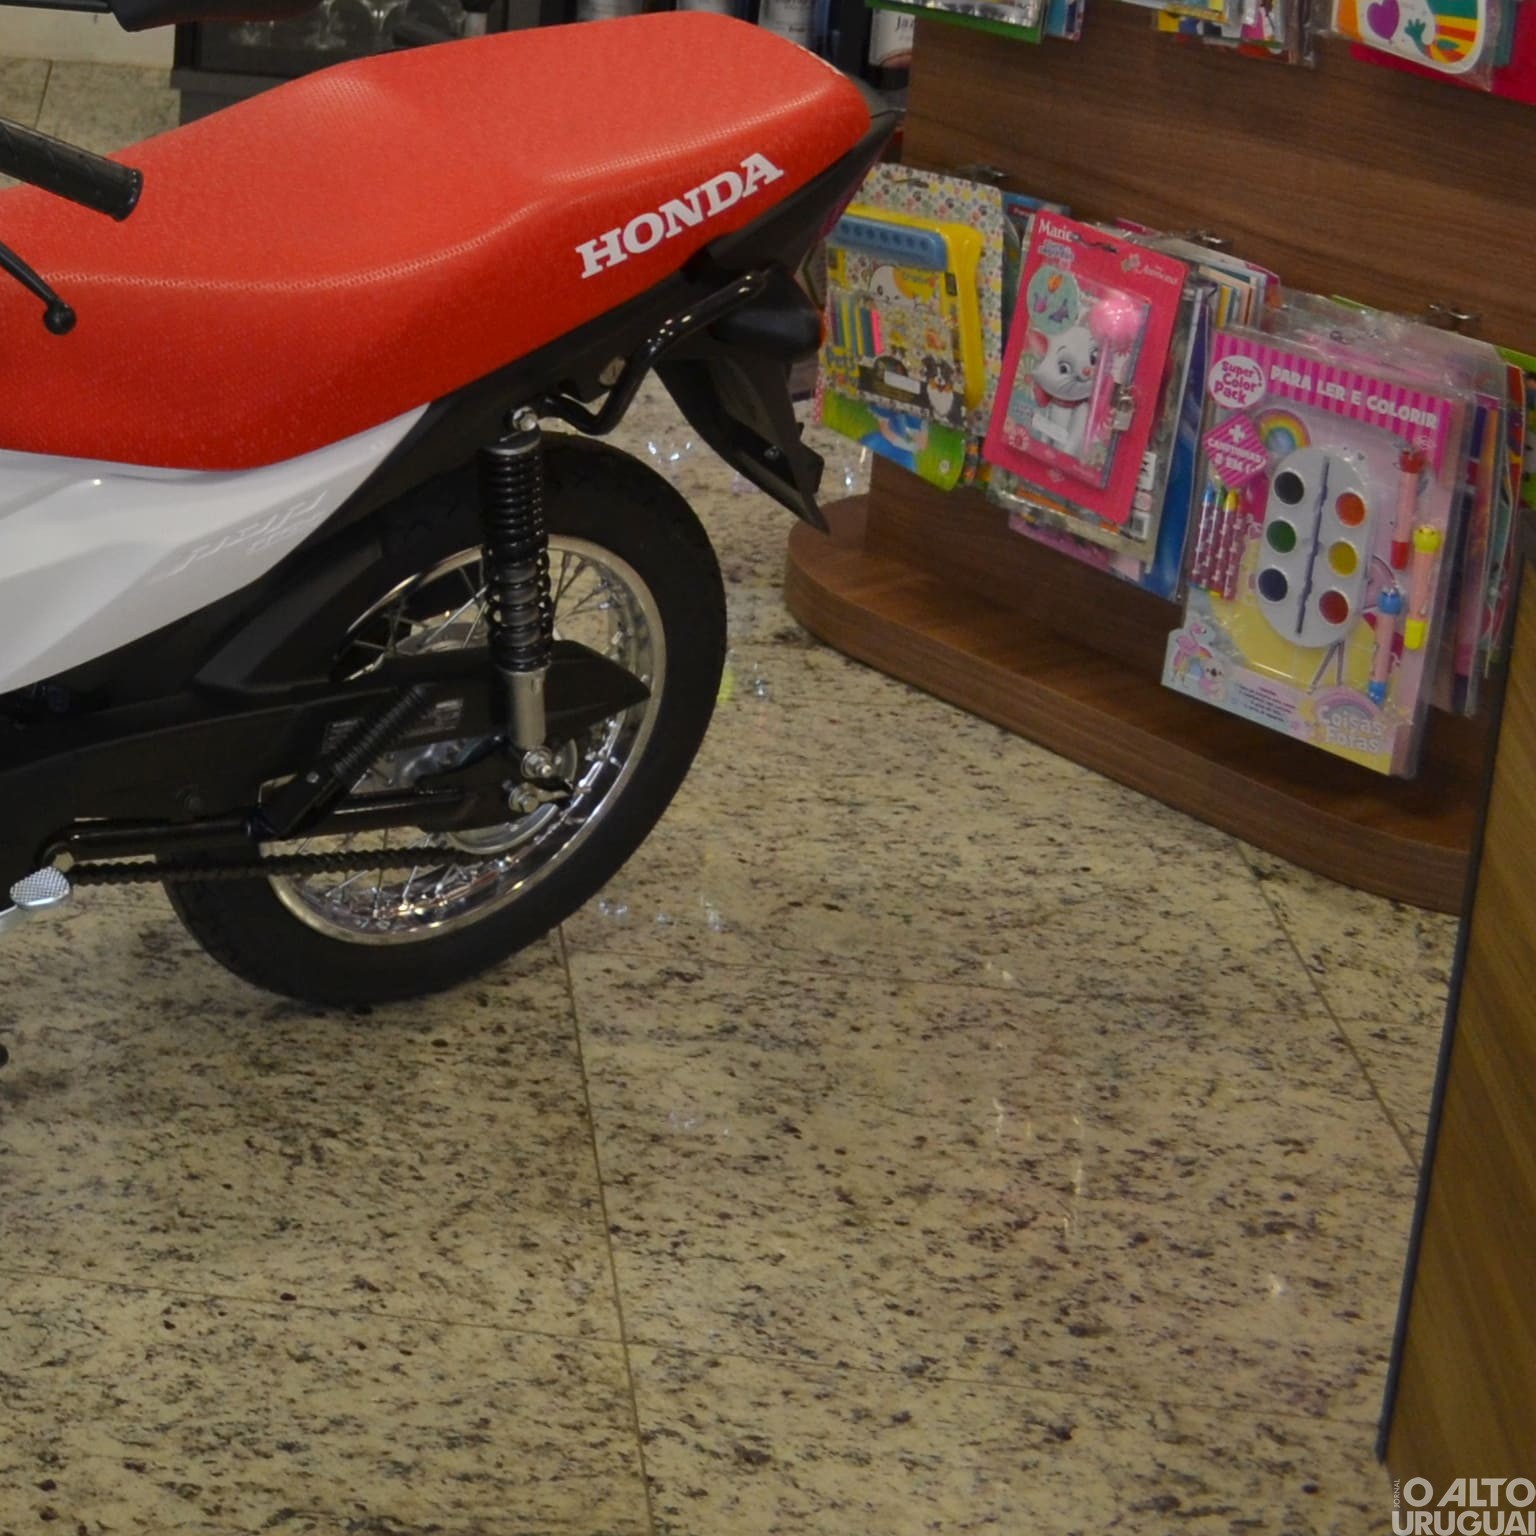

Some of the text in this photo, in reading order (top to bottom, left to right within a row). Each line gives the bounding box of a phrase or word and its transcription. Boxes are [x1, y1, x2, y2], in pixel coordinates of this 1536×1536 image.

[574, 151, 784, 281] HONDA
[1038, 218, 1074, 243] Marie
[1270, 365, 1439, 430] PARA LER E COLORIR
